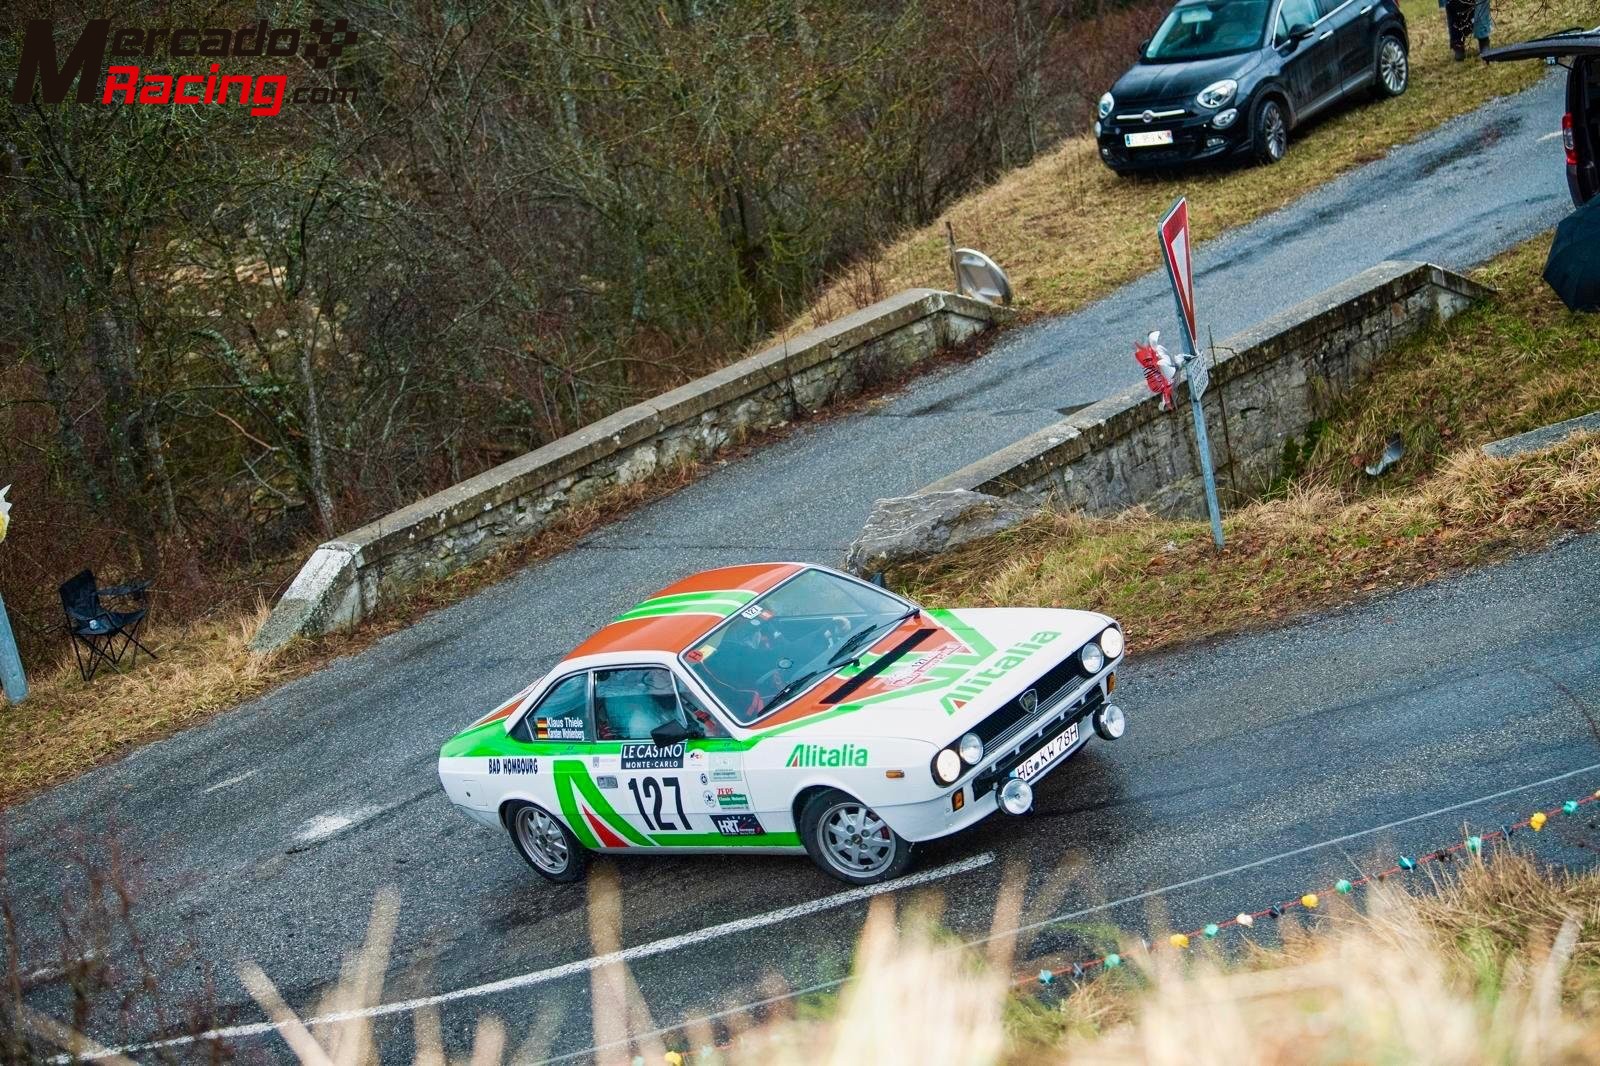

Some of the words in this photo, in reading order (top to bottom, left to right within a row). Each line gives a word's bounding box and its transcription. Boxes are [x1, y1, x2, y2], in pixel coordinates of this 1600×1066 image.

[940, 632, 1062, 716] Alitalia
[547, 717, 563, 728] Klaus
[564, 717, 583, 728] Thiele
[623, 745, 636, 759] LE
[637, 744, 682, 758] CASINO
[786, 743, 868, 767] Alitalia
[489, 758, 501, 775] BAD
[503, 757, 538, 776] HOMBOURG
[628, 776, 693, 831] 127
